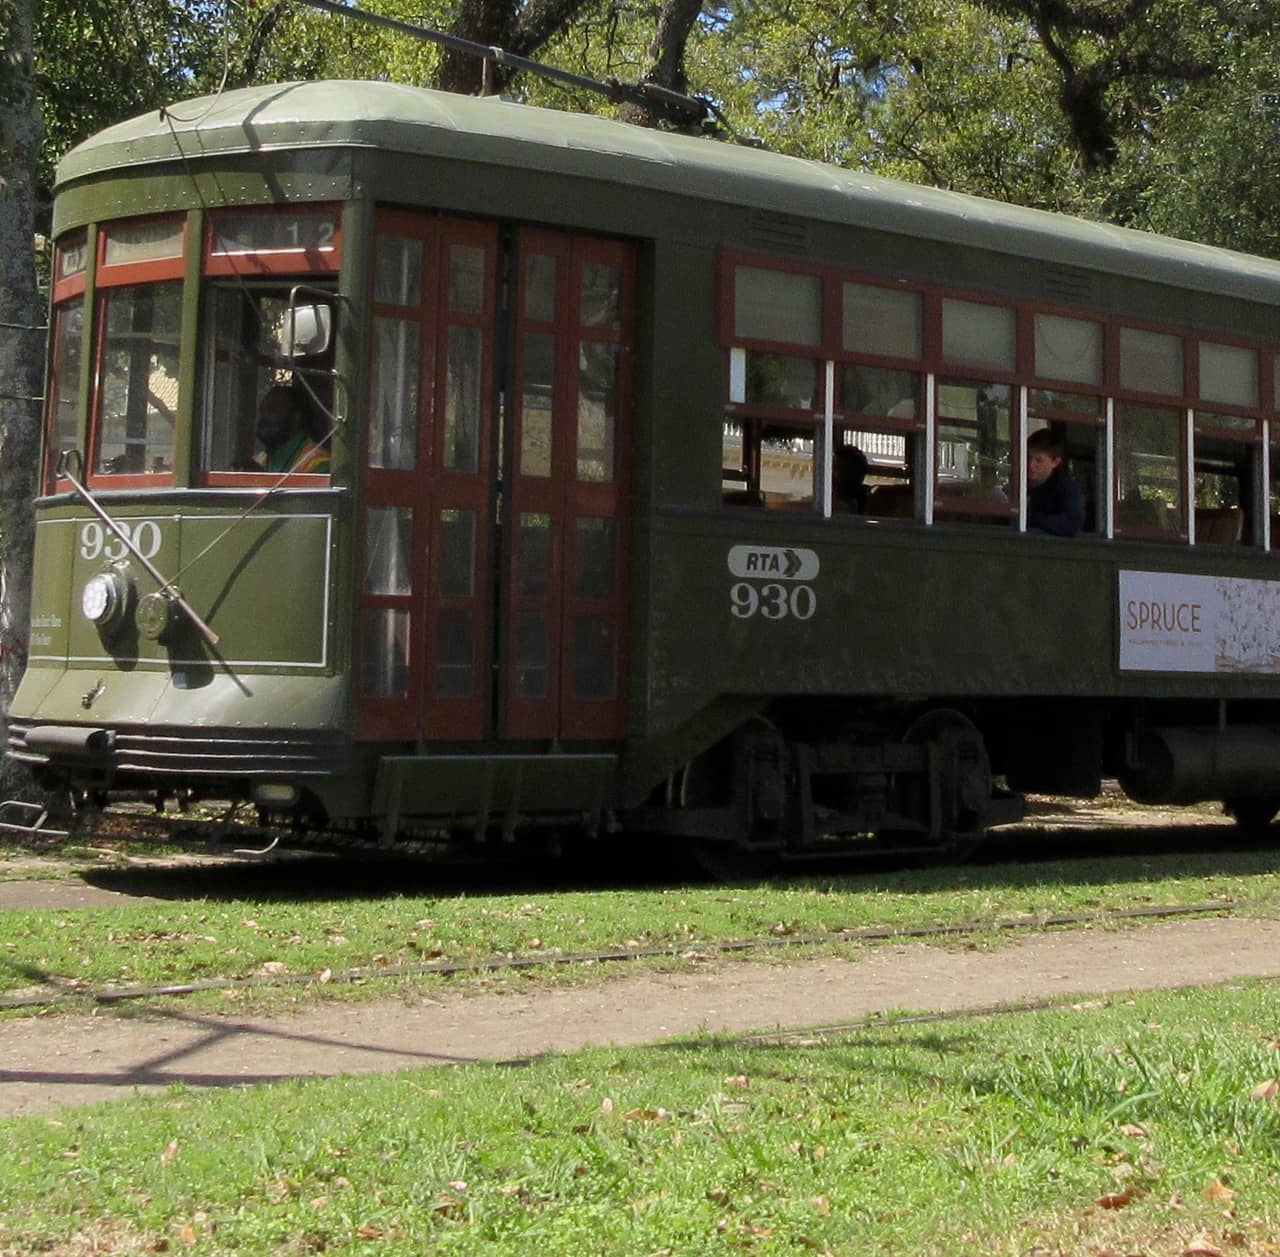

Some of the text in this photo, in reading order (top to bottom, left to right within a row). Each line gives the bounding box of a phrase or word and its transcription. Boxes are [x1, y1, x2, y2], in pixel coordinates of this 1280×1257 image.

[80, 521, 162, 560] 930
[746, 552, 780, 572] RTA
[730, 582, 817, 620] 930
[1127, 600, 1202, 632] SPRUCE
